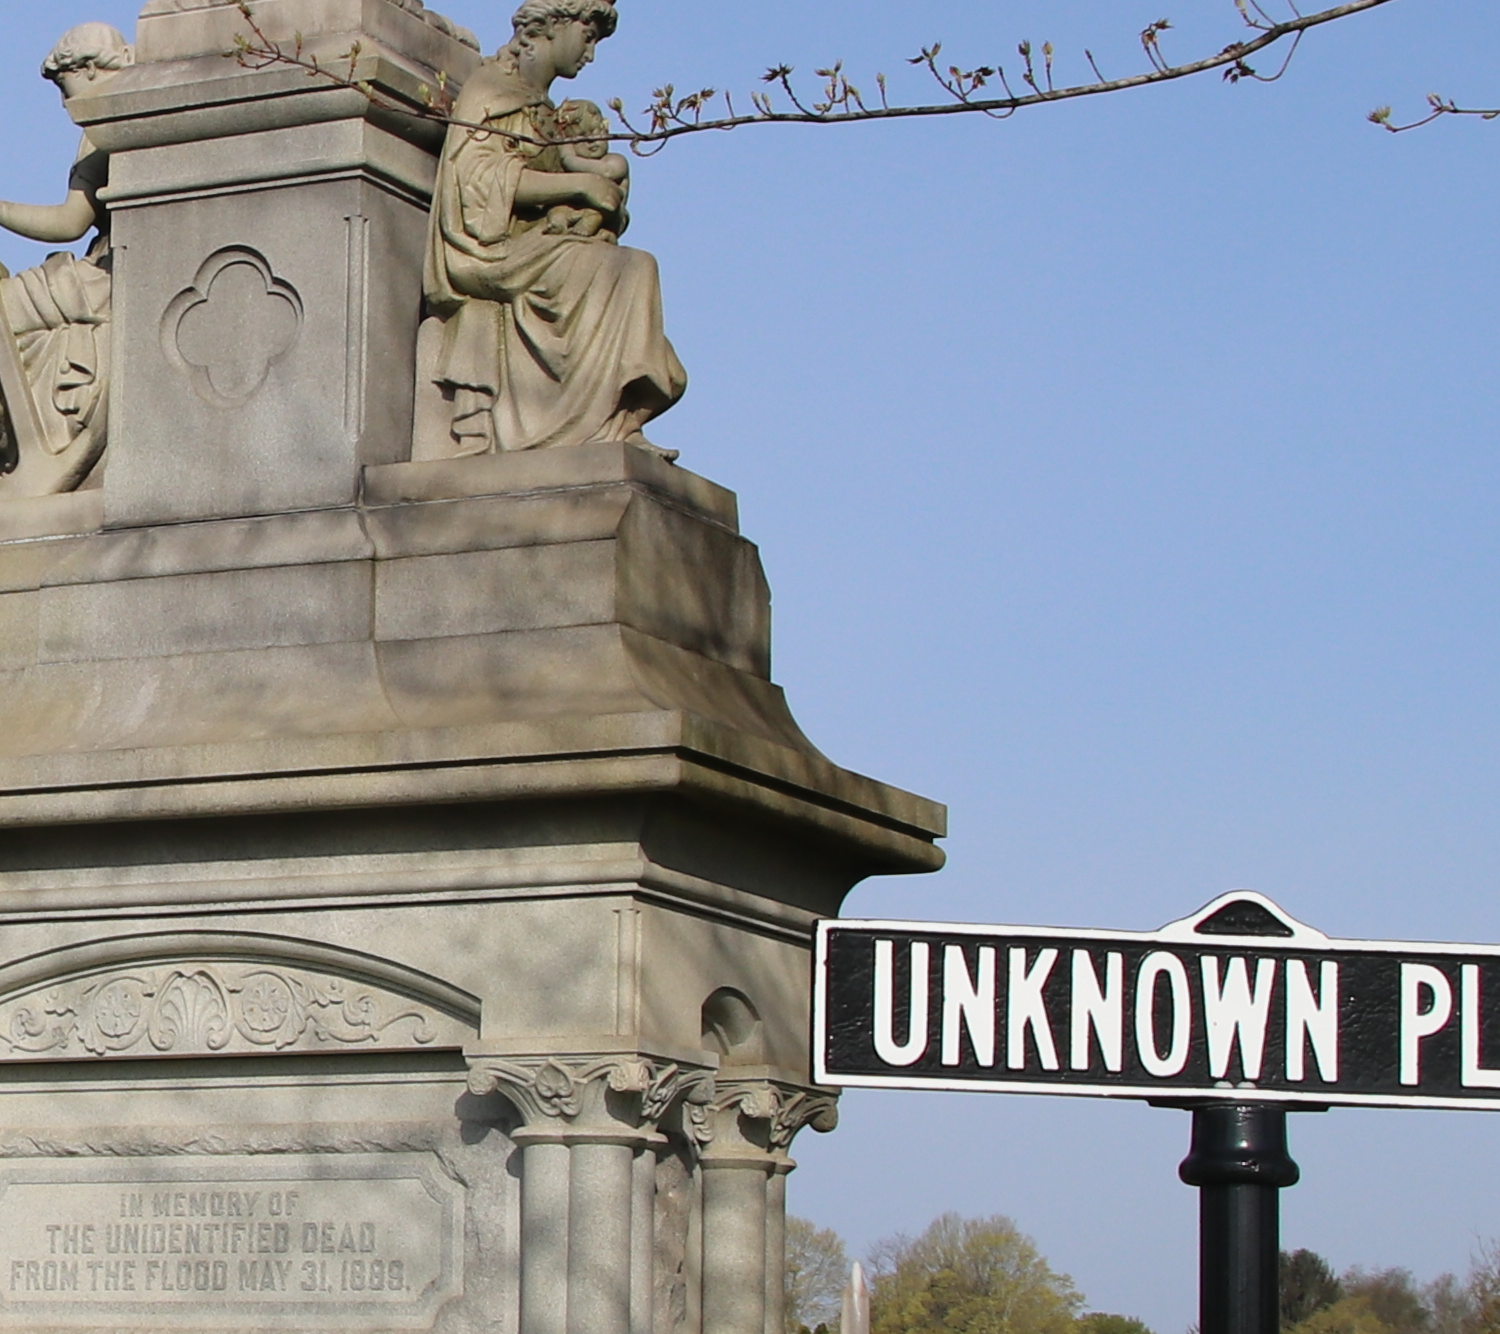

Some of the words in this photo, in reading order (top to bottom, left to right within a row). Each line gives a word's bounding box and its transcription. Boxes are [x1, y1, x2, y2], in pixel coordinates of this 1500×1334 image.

[873, 938, 1339, 1085] UNKNOWN
[119, 1193, 145, 1218] IN
[152, 1191, 260, 1217] MEMORY
[268, 1190, 300, 1216] OF
[46, 1224, 96, 1255] THE
[105, 1223, 291, 1255] UNIDENTIFIED
[300, 1222, 376, 1253] DEAD
[9, 1260, 80, 1292] FROM
[86, 1260, 138, 1292] THE
[144, 1260, 228, 1292] FLOOD
[237, 1259, 292, 1291] MAY
[300, 1260, 332, 1294] 31,
[340, 1259, 411, 1291] 1889.
